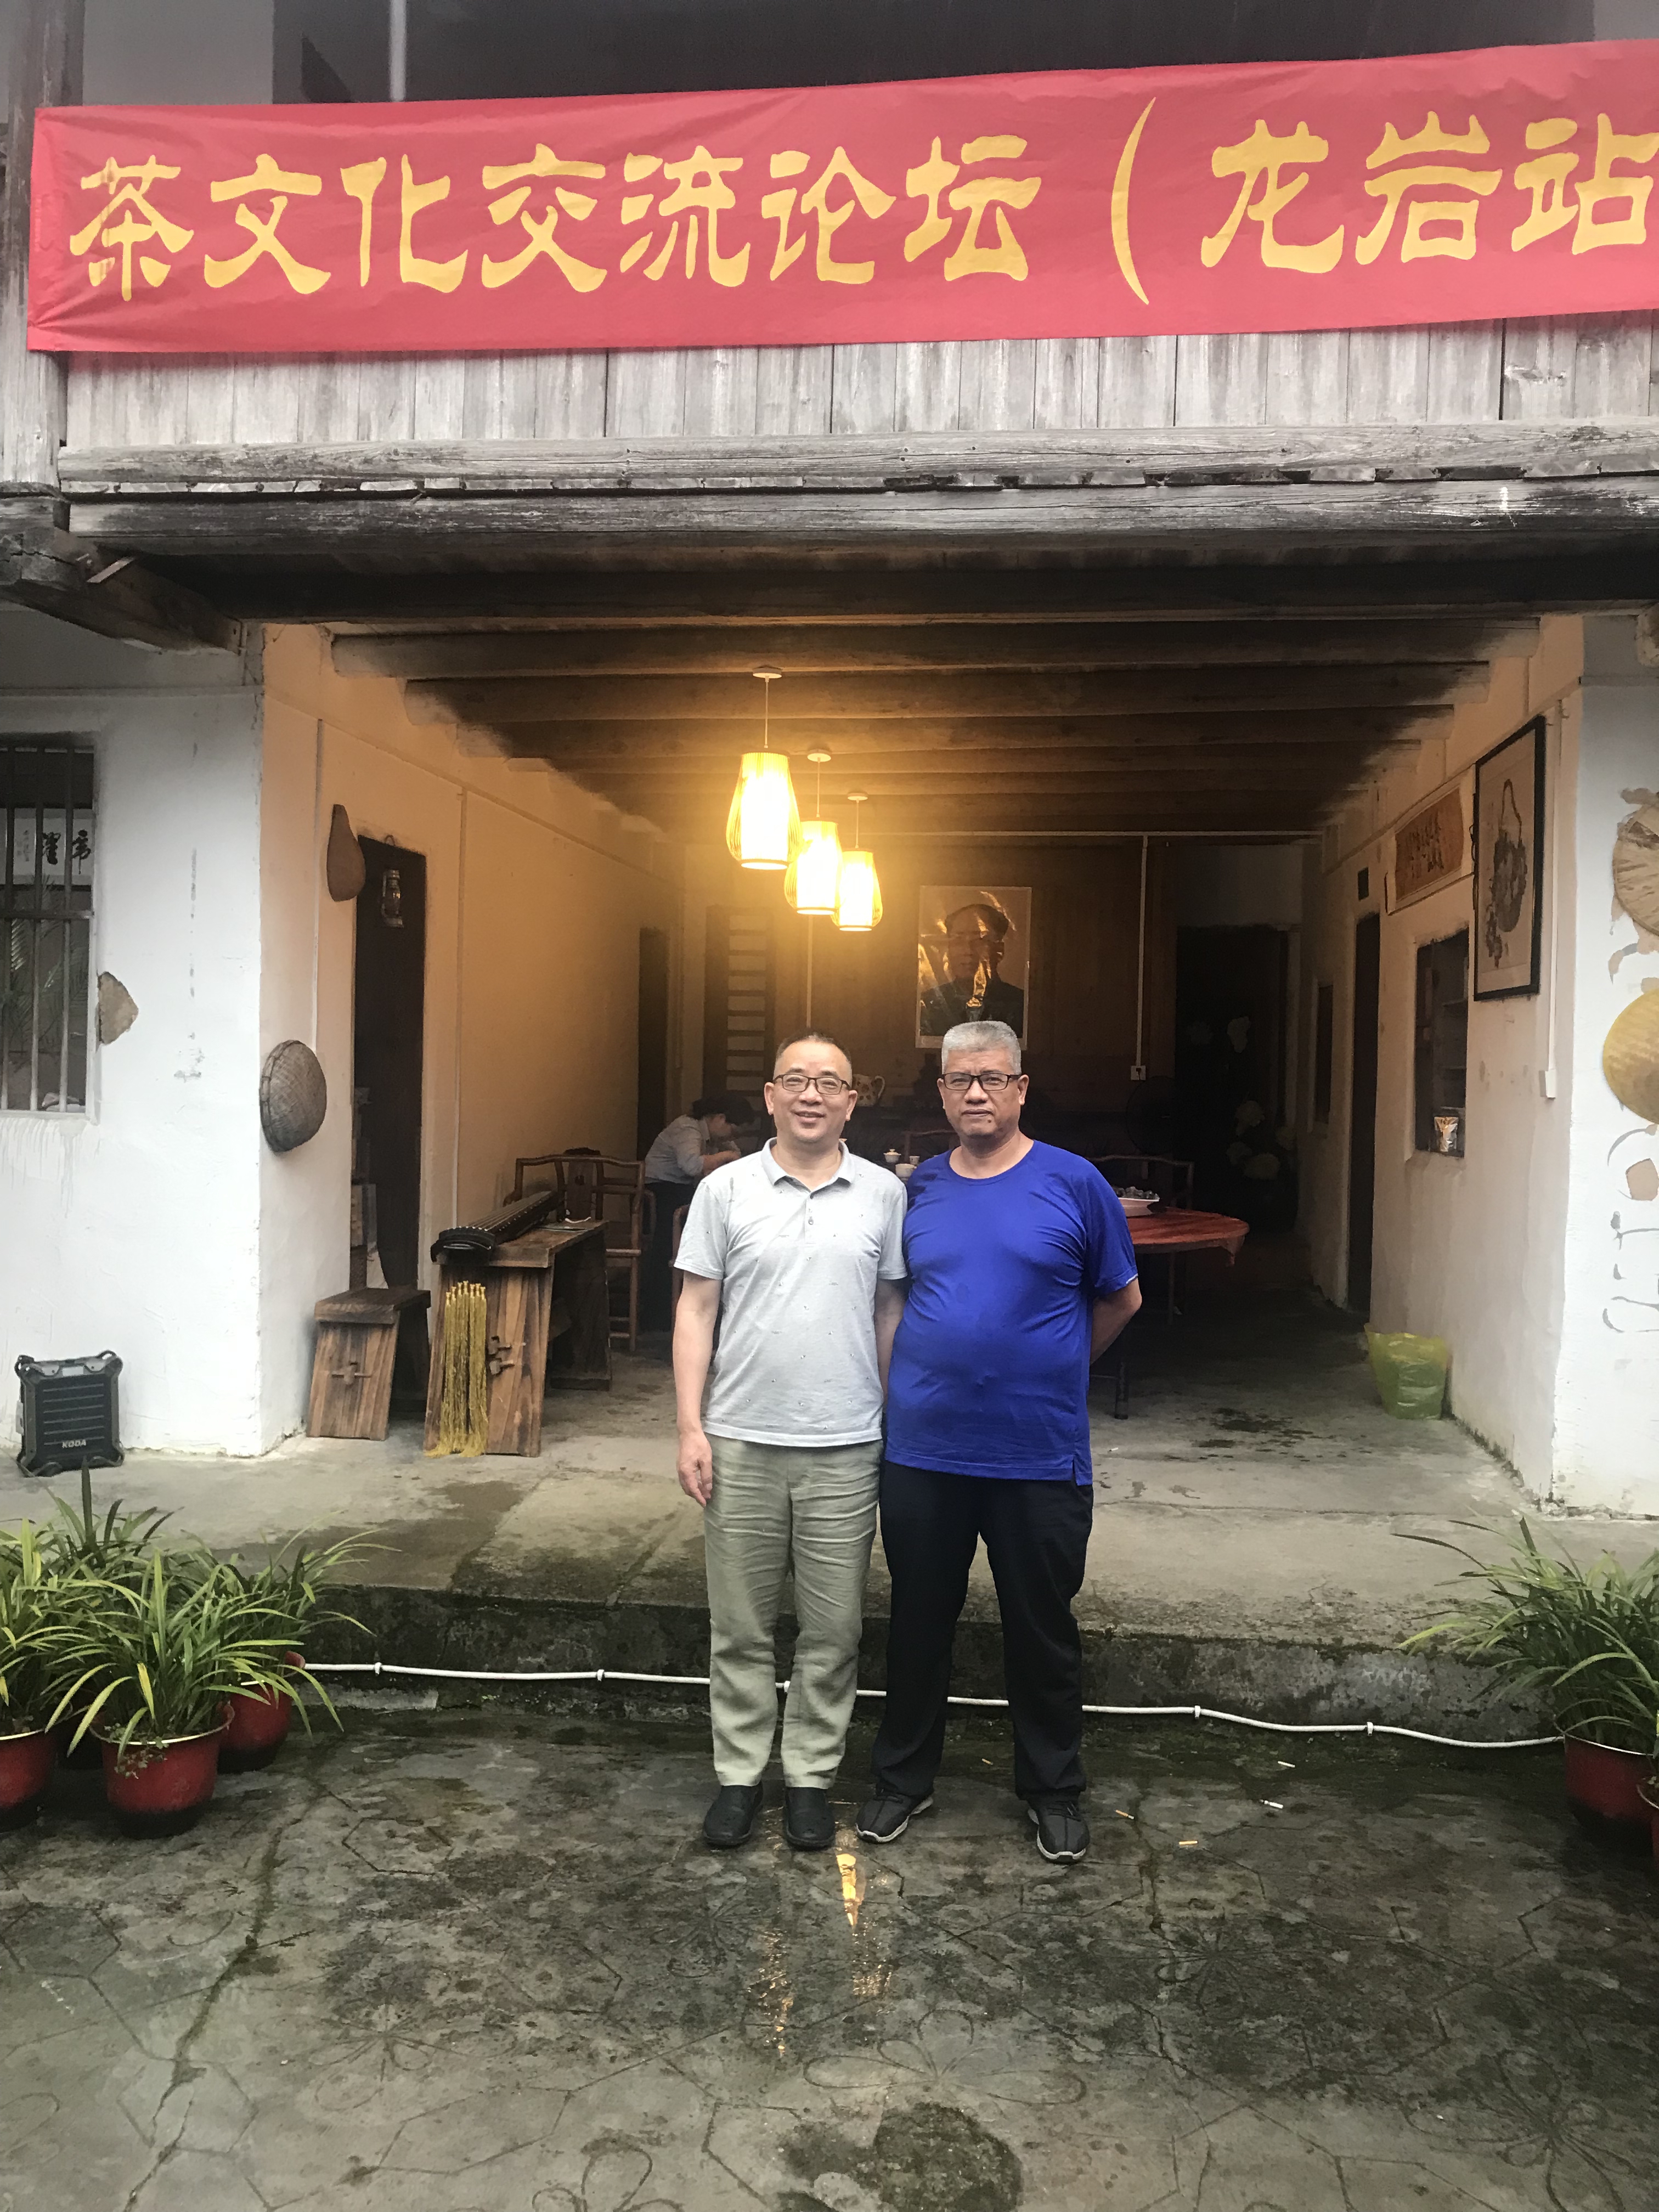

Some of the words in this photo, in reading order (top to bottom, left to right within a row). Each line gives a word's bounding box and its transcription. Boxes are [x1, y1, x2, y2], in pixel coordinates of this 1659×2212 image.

[69, 96, 1659, 304] 茶文化交流论坛（龙岩站
